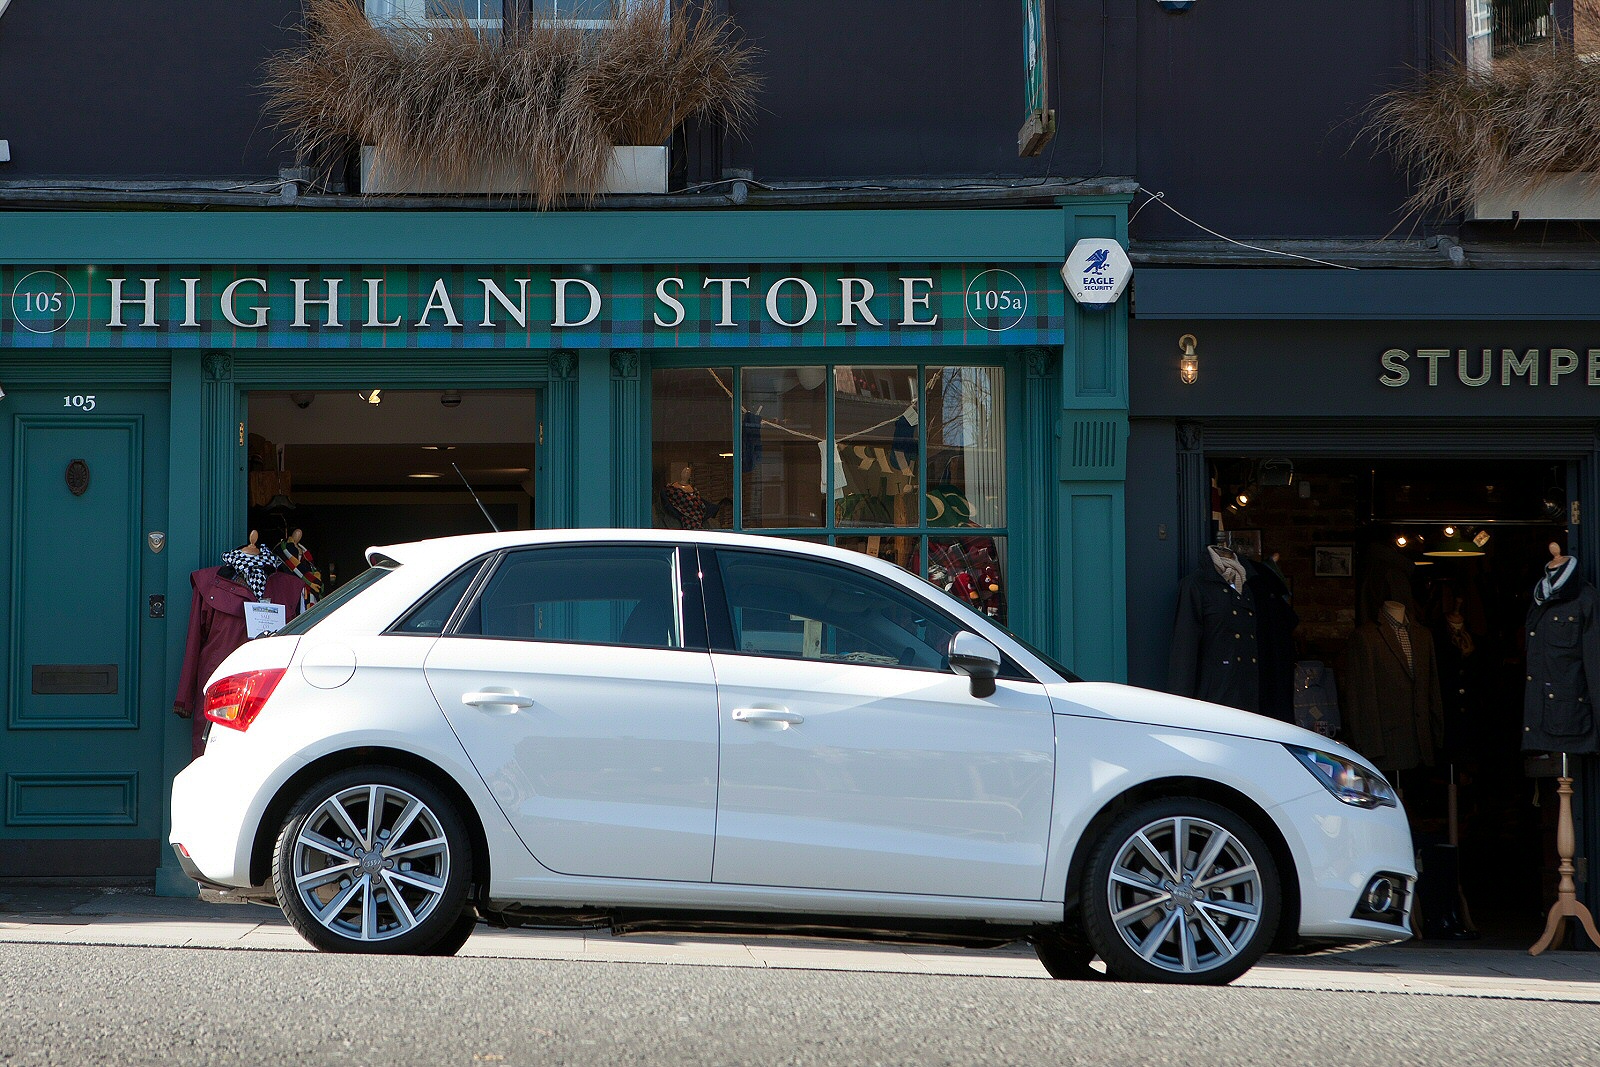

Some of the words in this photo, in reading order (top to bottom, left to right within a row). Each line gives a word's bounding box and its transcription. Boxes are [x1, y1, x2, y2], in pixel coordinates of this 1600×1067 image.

[24, 291, 62, 312] 105
[106, 277, 603, 328] HIGHLAND
[653, 276, 938, 327] STORE
[974, 290, 1022, 310] 105a
[63, 395, 96, 412] 105
